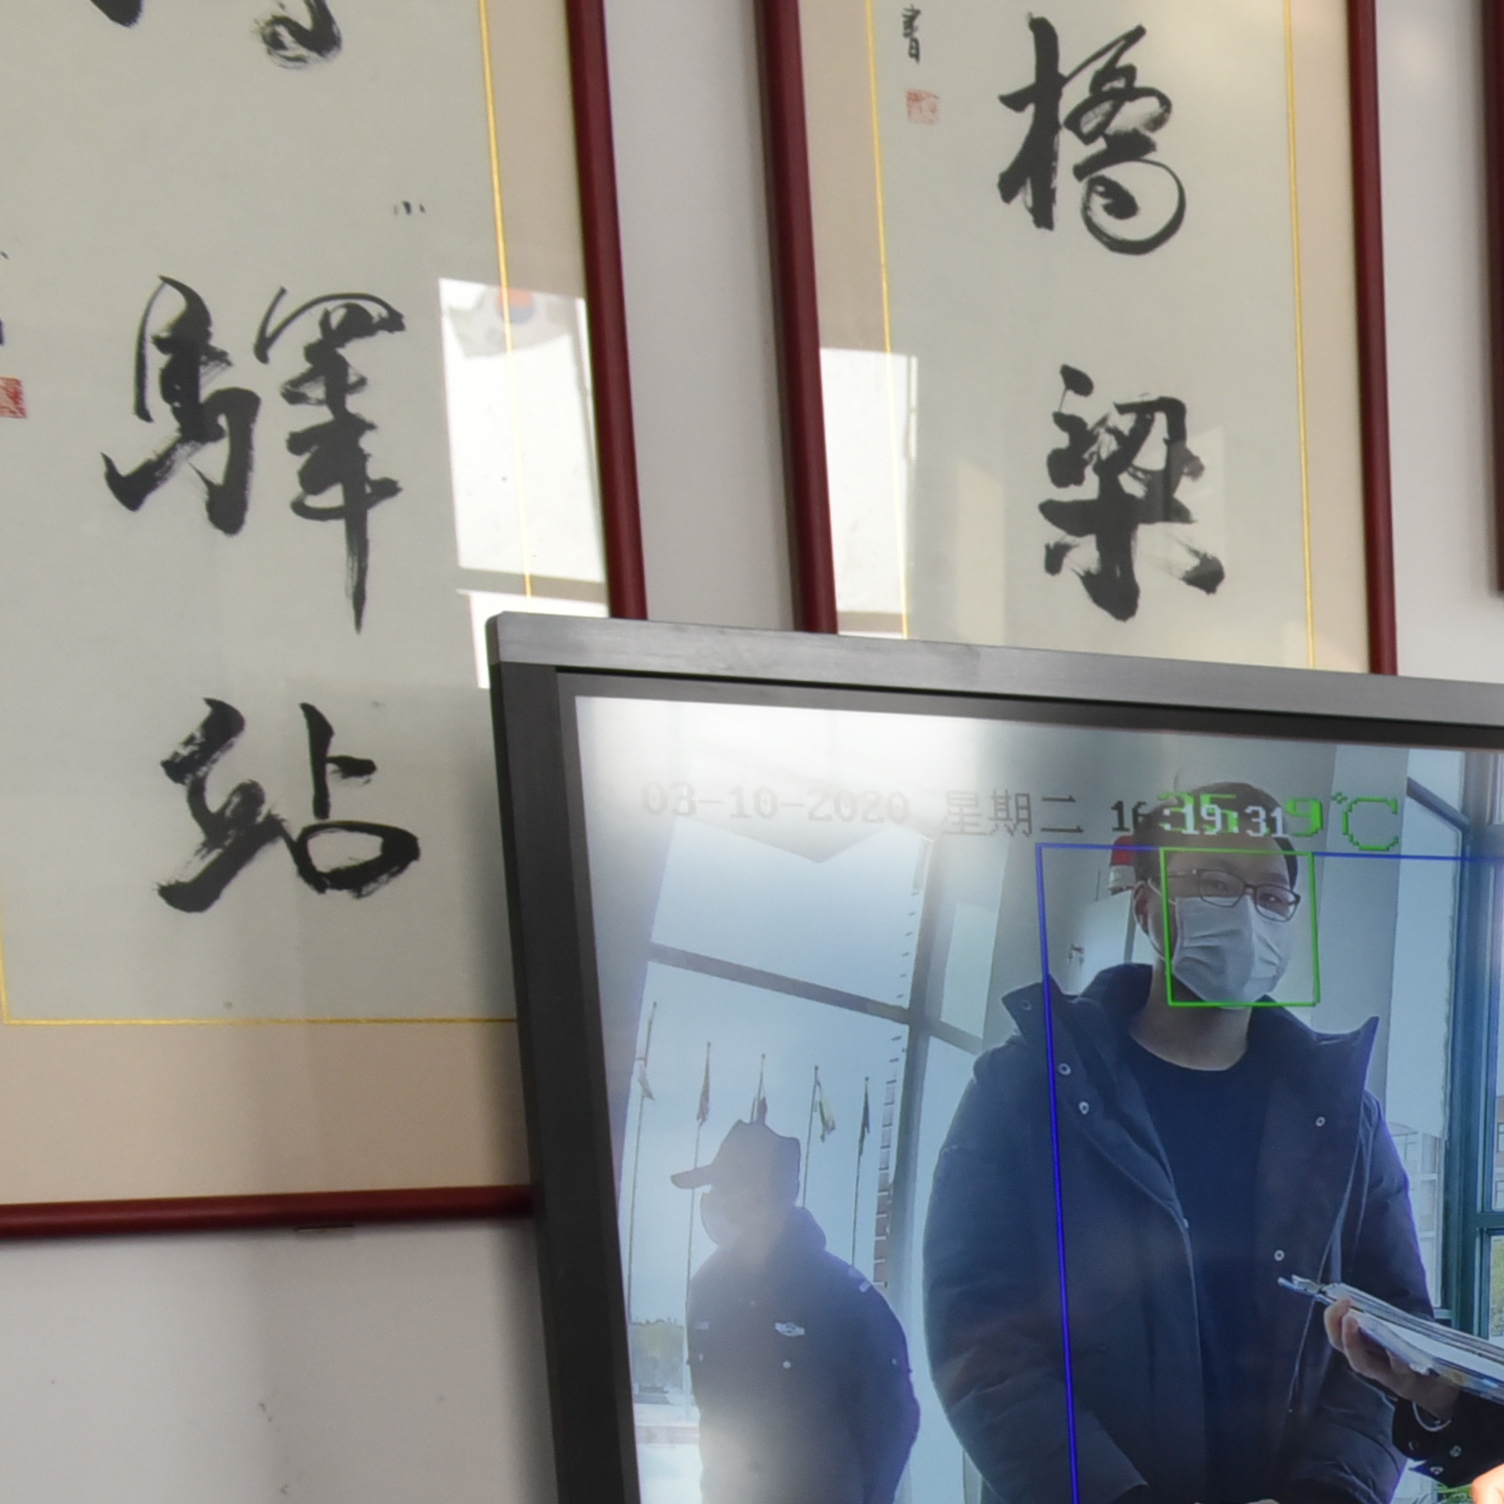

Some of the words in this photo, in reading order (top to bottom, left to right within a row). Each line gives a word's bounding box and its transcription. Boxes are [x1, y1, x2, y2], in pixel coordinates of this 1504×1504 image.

[641, 780, 911, 826] 03-10-2020
[940, 786, 1084, 837] 星期二
